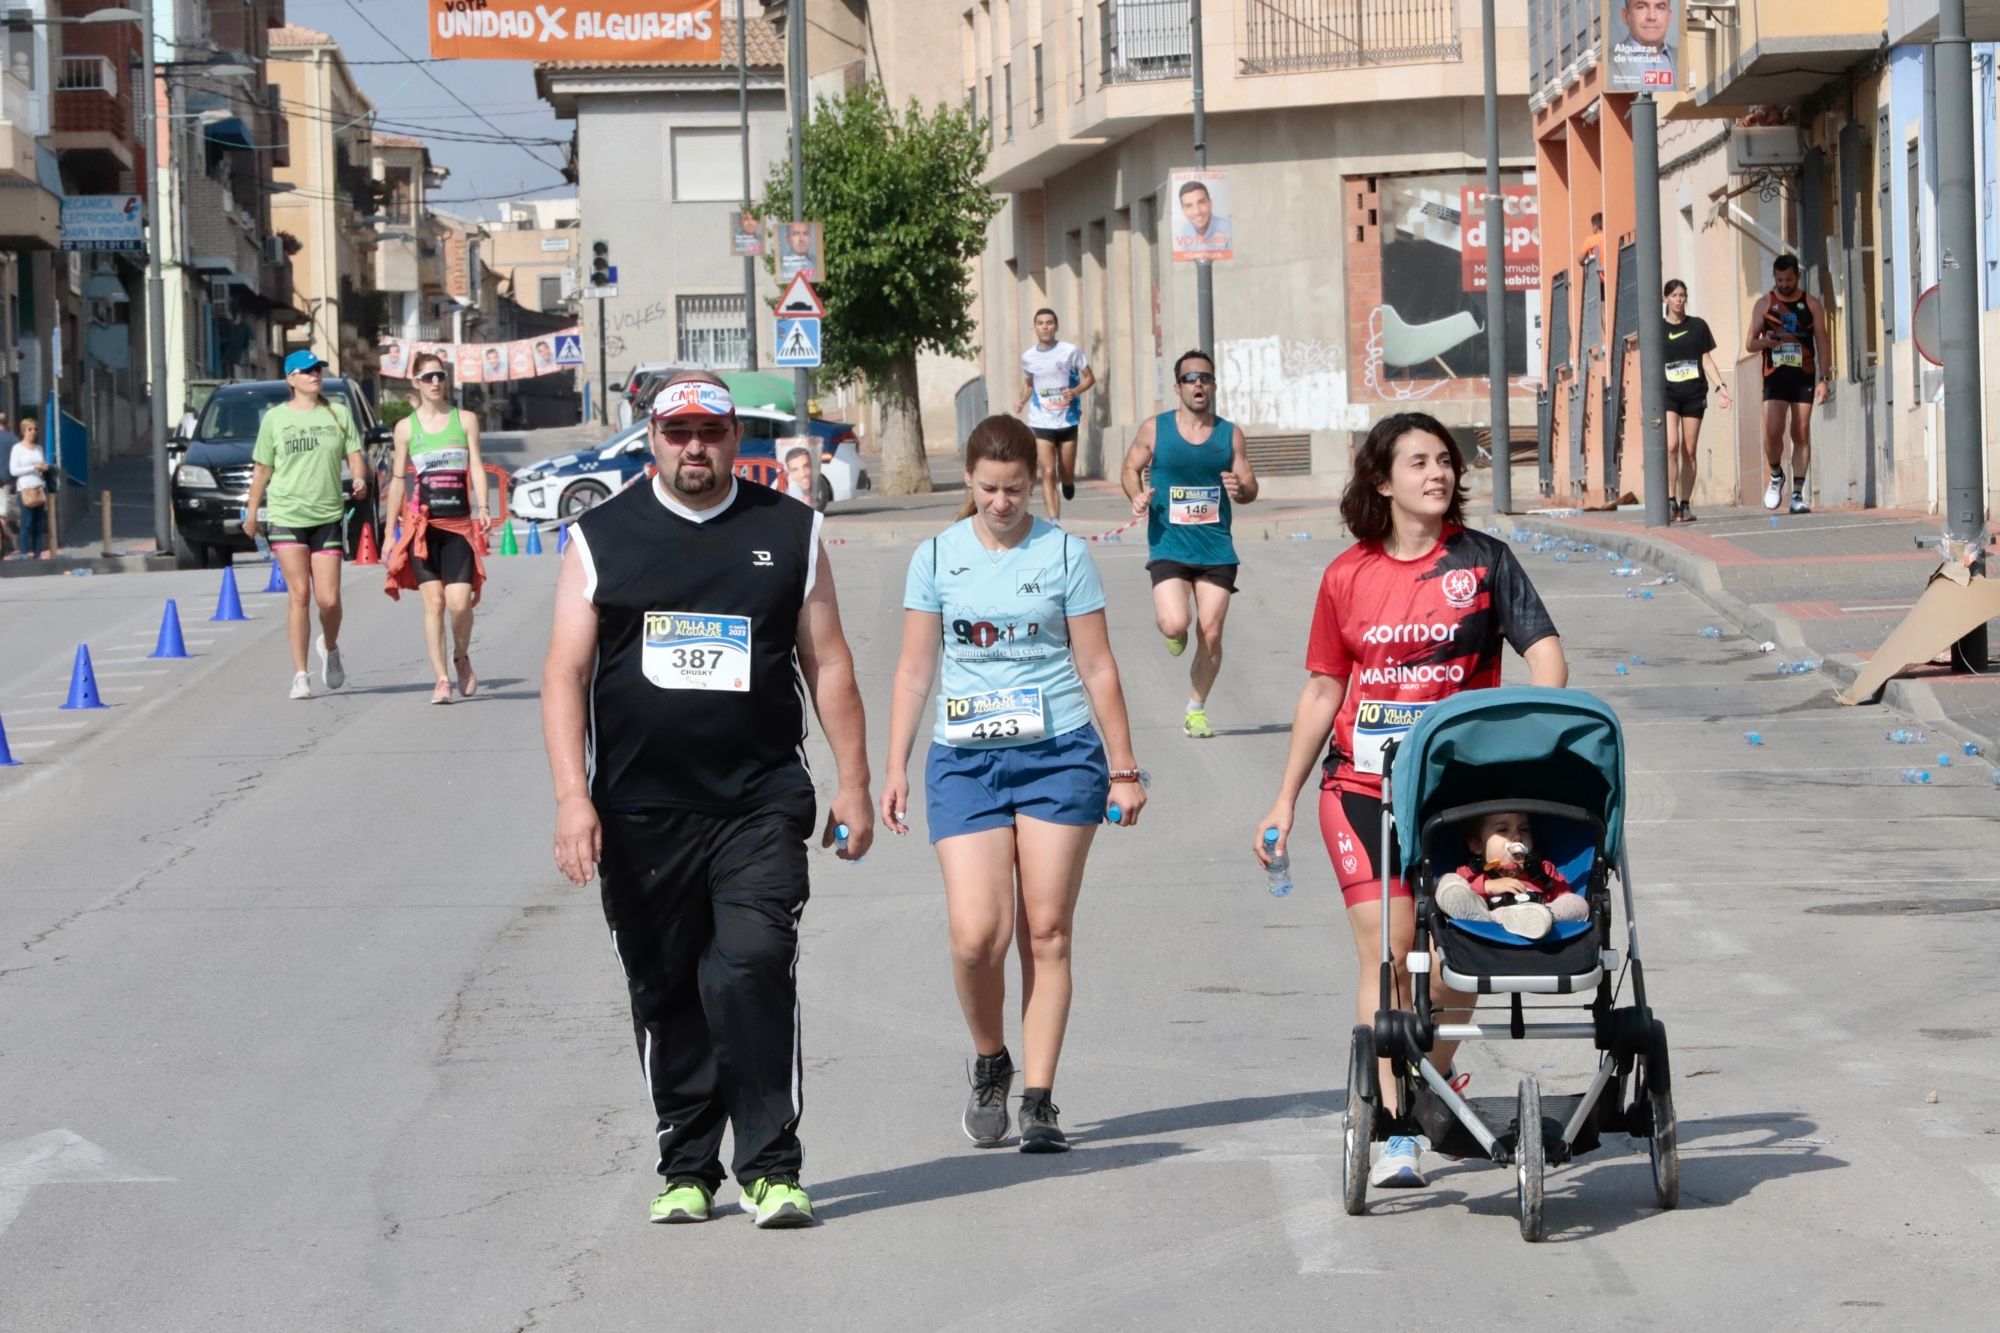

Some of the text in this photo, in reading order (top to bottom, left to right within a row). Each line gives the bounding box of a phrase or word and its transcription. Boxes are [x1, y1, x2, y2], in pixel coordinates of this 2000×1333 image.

[445, 0, 487, 12] VOTA
[437, 5, 713, 42] UNIDAD X ALGUAZAS
[1614, 43, 1657, 54] Alguazas
[1614, 54, 1662, 64] de verdad.
[62, 212, 125, 224] LECTRICIDAD
[90, 226, 98, 237] Y
[99, 226, 139, 238] PINTURA
[671, 389, 716, 402] CAMINO
[1185, 504, 1208, 514] 146
[1017, 582, 1041, 594] AXA
[675, 620, 705, 630] VILLA
[707, 621, 722, 631] DE
[675, 627, 722, 637] ALGUAZAS
[995, 647, 1008, 657] de
[671, 648, 724, 669] 387
[680, 669, 713, 677] CHUSKY
[1384, 708, 1412, 718] VILLA
[971, 718, 1020, 739] 423
